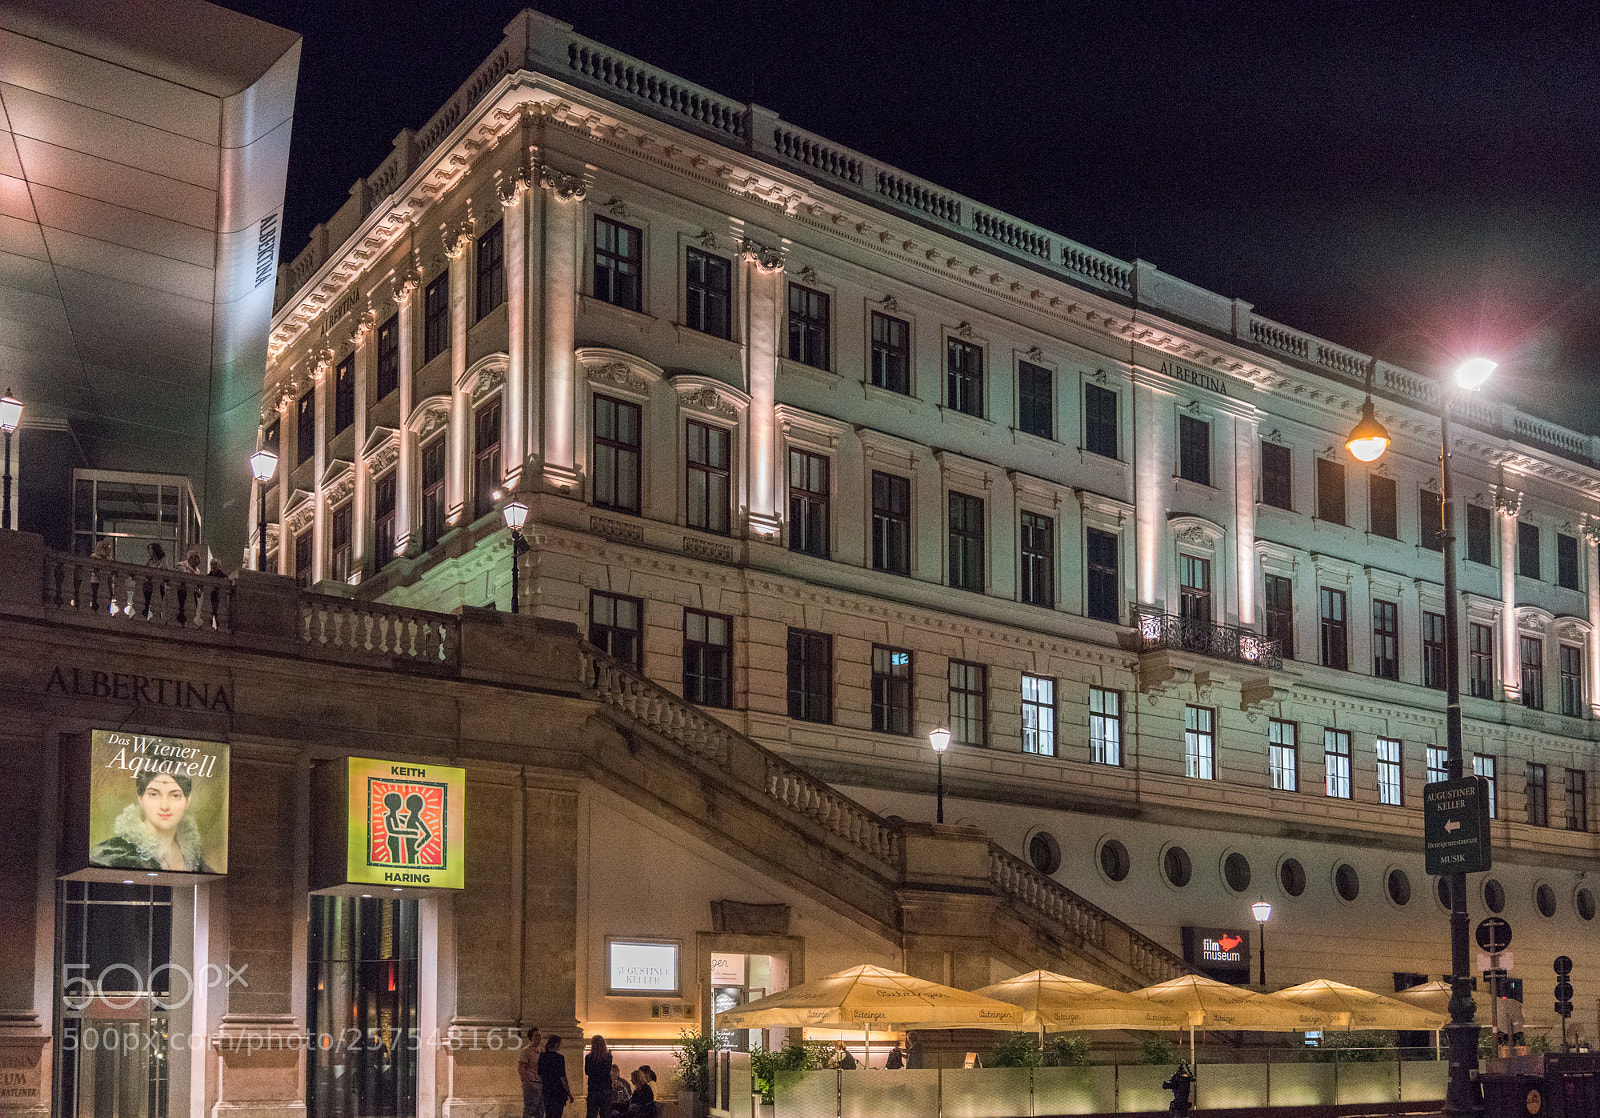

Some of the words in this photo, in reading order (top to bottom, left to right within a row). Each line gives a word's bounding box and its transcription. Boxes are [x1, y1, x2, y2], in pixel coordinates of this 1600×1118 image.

[255, 213, 278, 288] ALBERTINA
[320, 289, 360, 337] ALBERTINA
[1160, 361, 1227, 395] ALBERTINA
[45, 666, 233, 712] ALBERTINA
[108, 734, 131, 746] Das
[133, 735, 200, 759] Wiener
[105, 747, 216, 778] Aquarell
[391, 766, 426, 778] KEITH
[1427, 787, 1476, 801] AUGUSTINER
[1437, 800, 1466, 811] KELLER
[1441, 854, 1466, 864] MUSIK
[384, 872, 430, 883] HARING
[1203, 938, 1220, 951] film
[1203, 950, 1240, 961] museum
[617, 966, 671, 976] AUGUSTINER
[626, 975, 660, 985] KELLER
